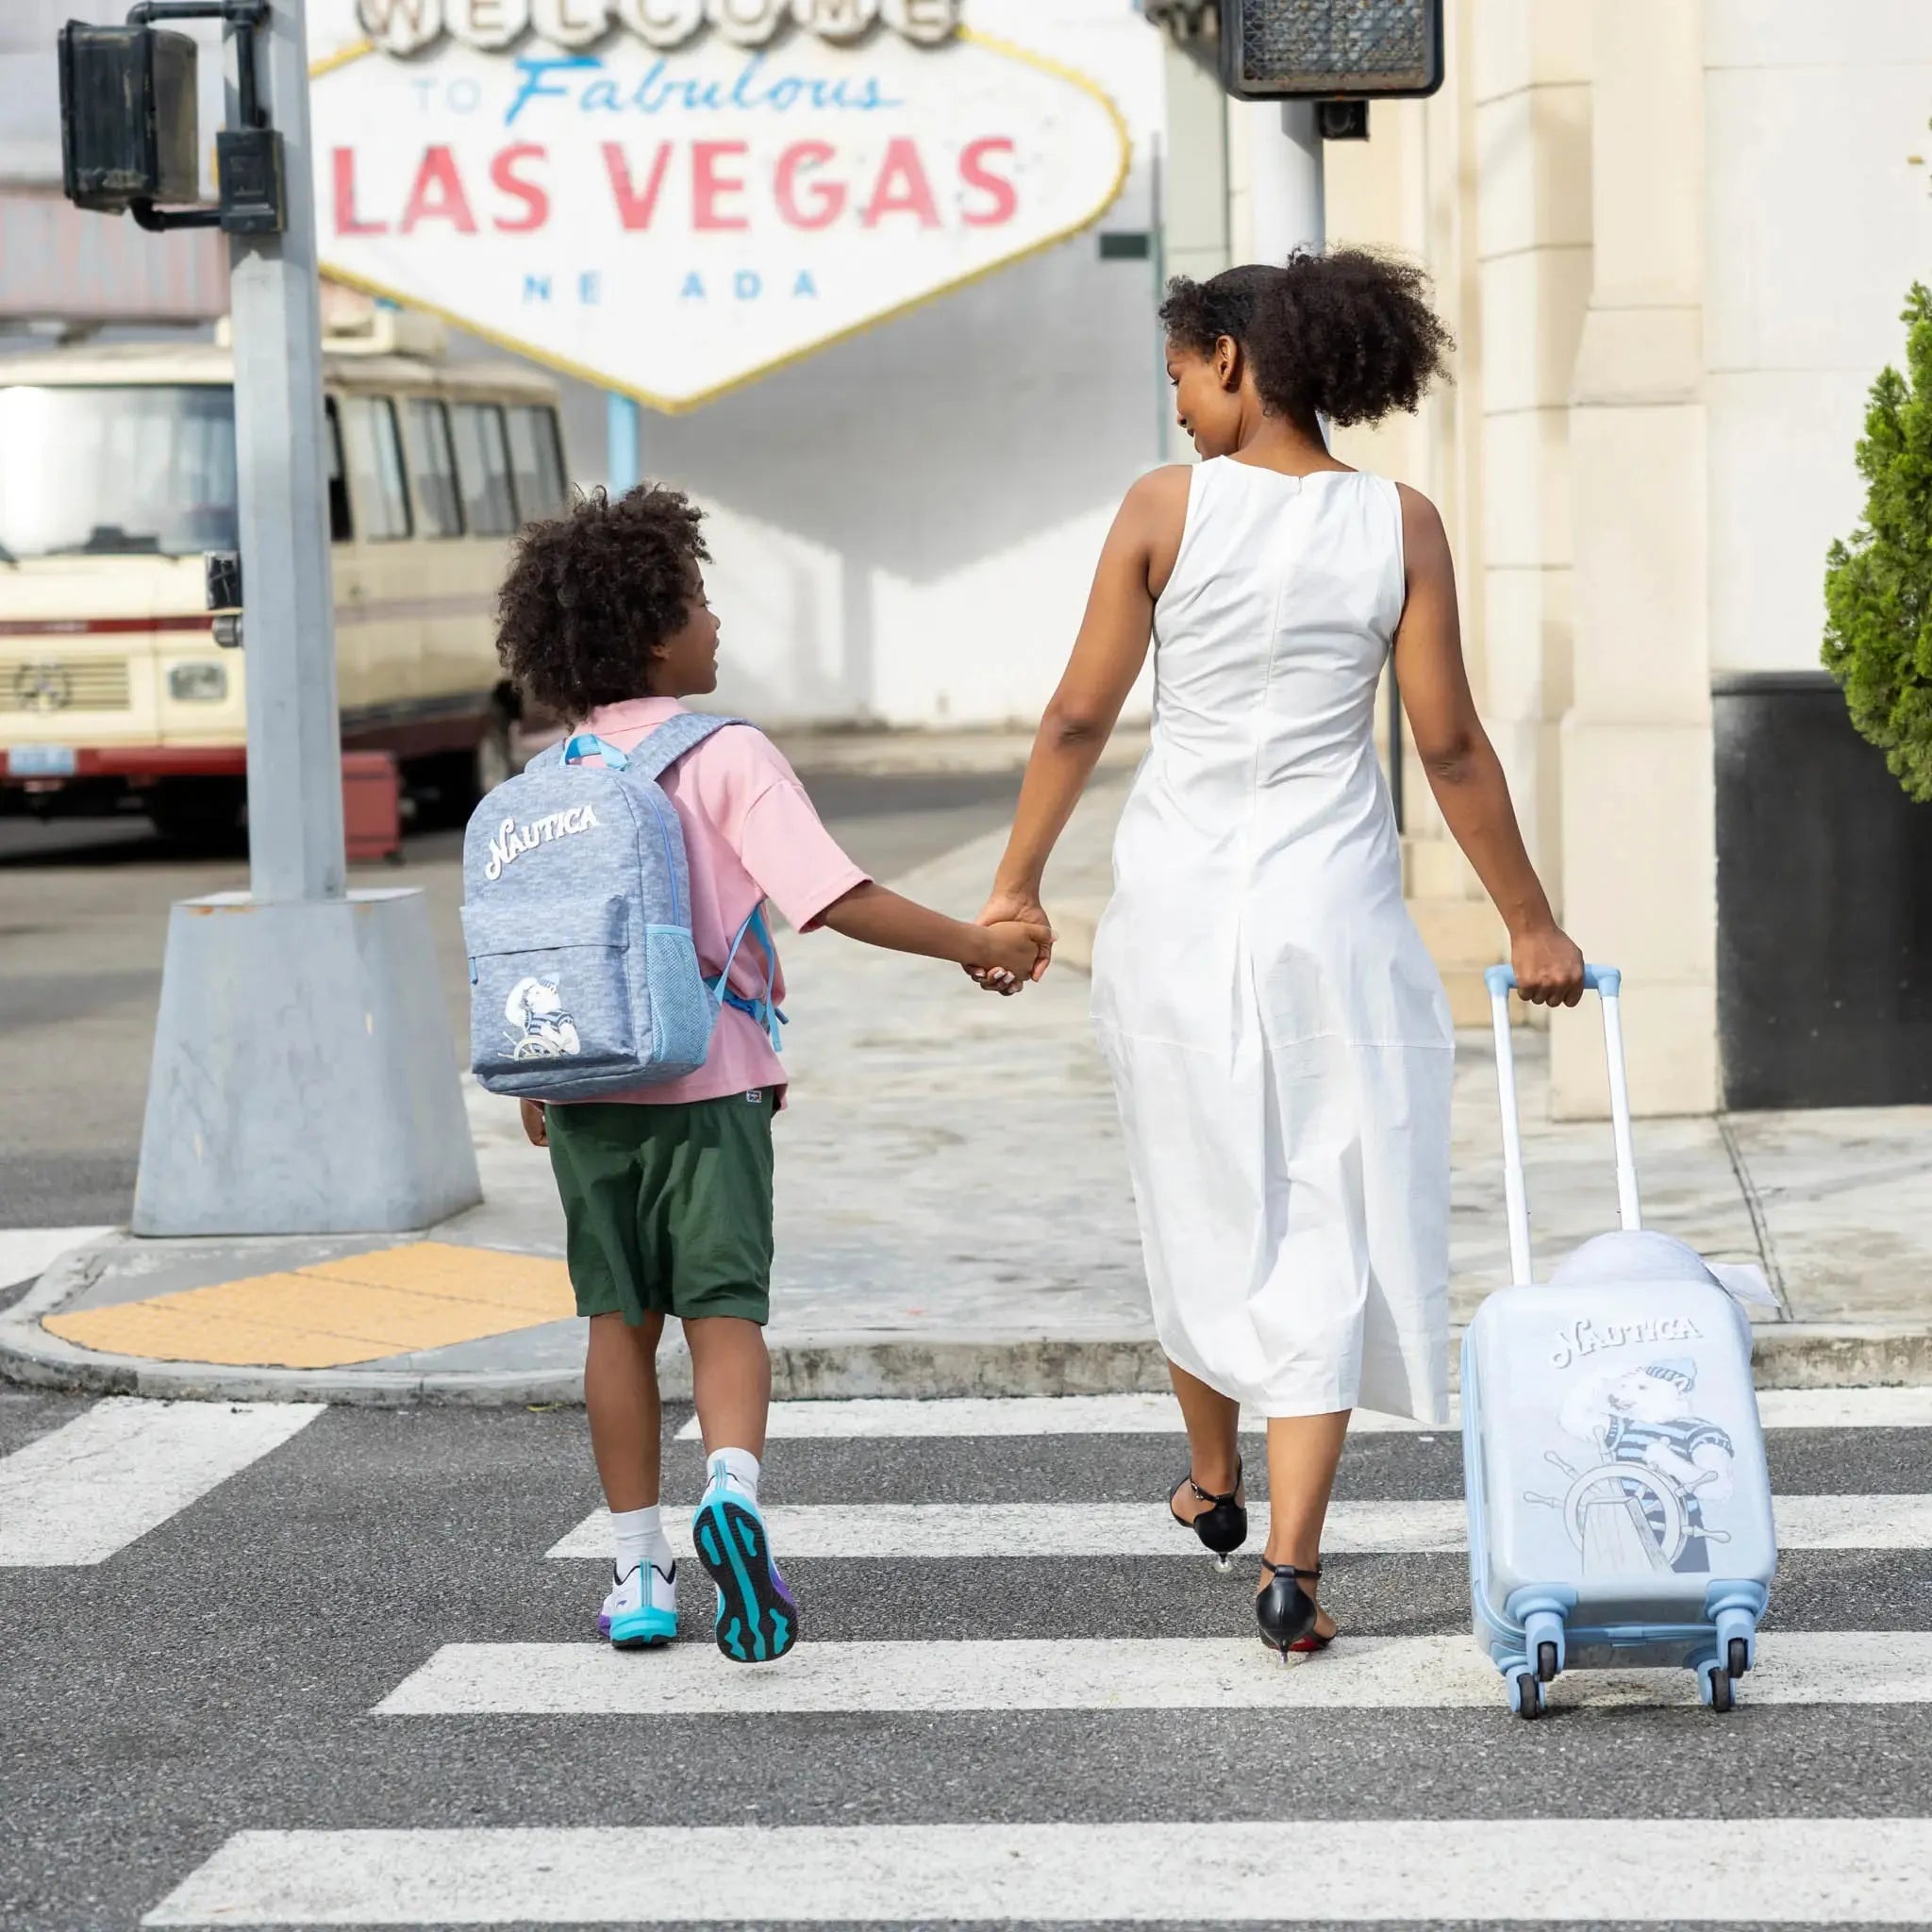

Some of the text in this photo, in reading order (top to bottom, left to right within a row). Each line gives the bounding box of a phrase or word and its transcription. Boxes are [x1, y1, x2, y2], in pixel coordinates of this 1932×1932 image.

[411, 53, 904, 126] TO Fabulous
[331, 137, 1020, 235] LAS VEGAS
[485, 802, 599, 881] NAUTICA
[1550, 1319, 1704, 1368] NAUTICA
